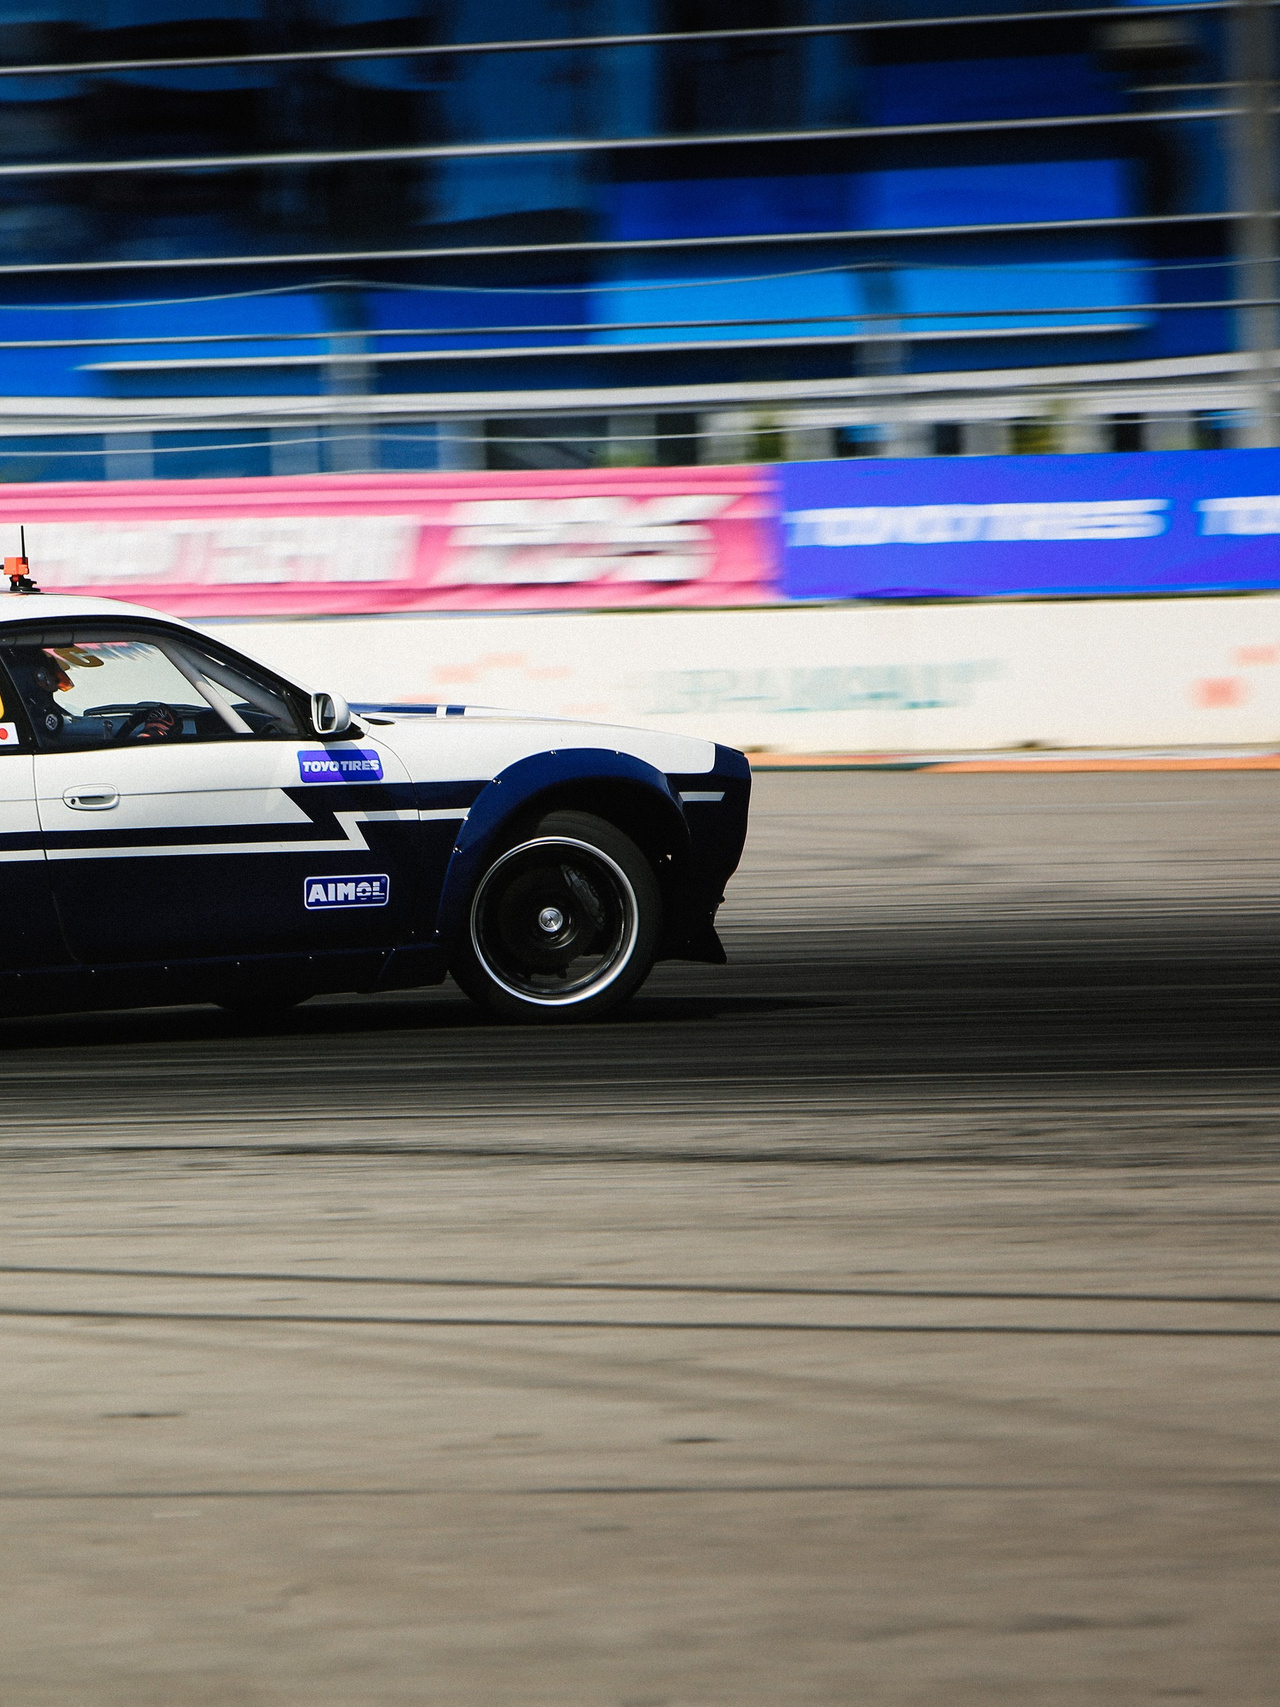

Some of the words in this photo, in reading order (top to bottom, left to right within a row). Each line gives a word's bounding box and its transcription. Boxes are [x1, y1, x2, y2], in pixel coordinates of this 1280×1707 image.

[302, 760, 340, 773] TOYO
[340, 759, 380, 772] TIRES
[307, 881, 386, 903] AIMOL
